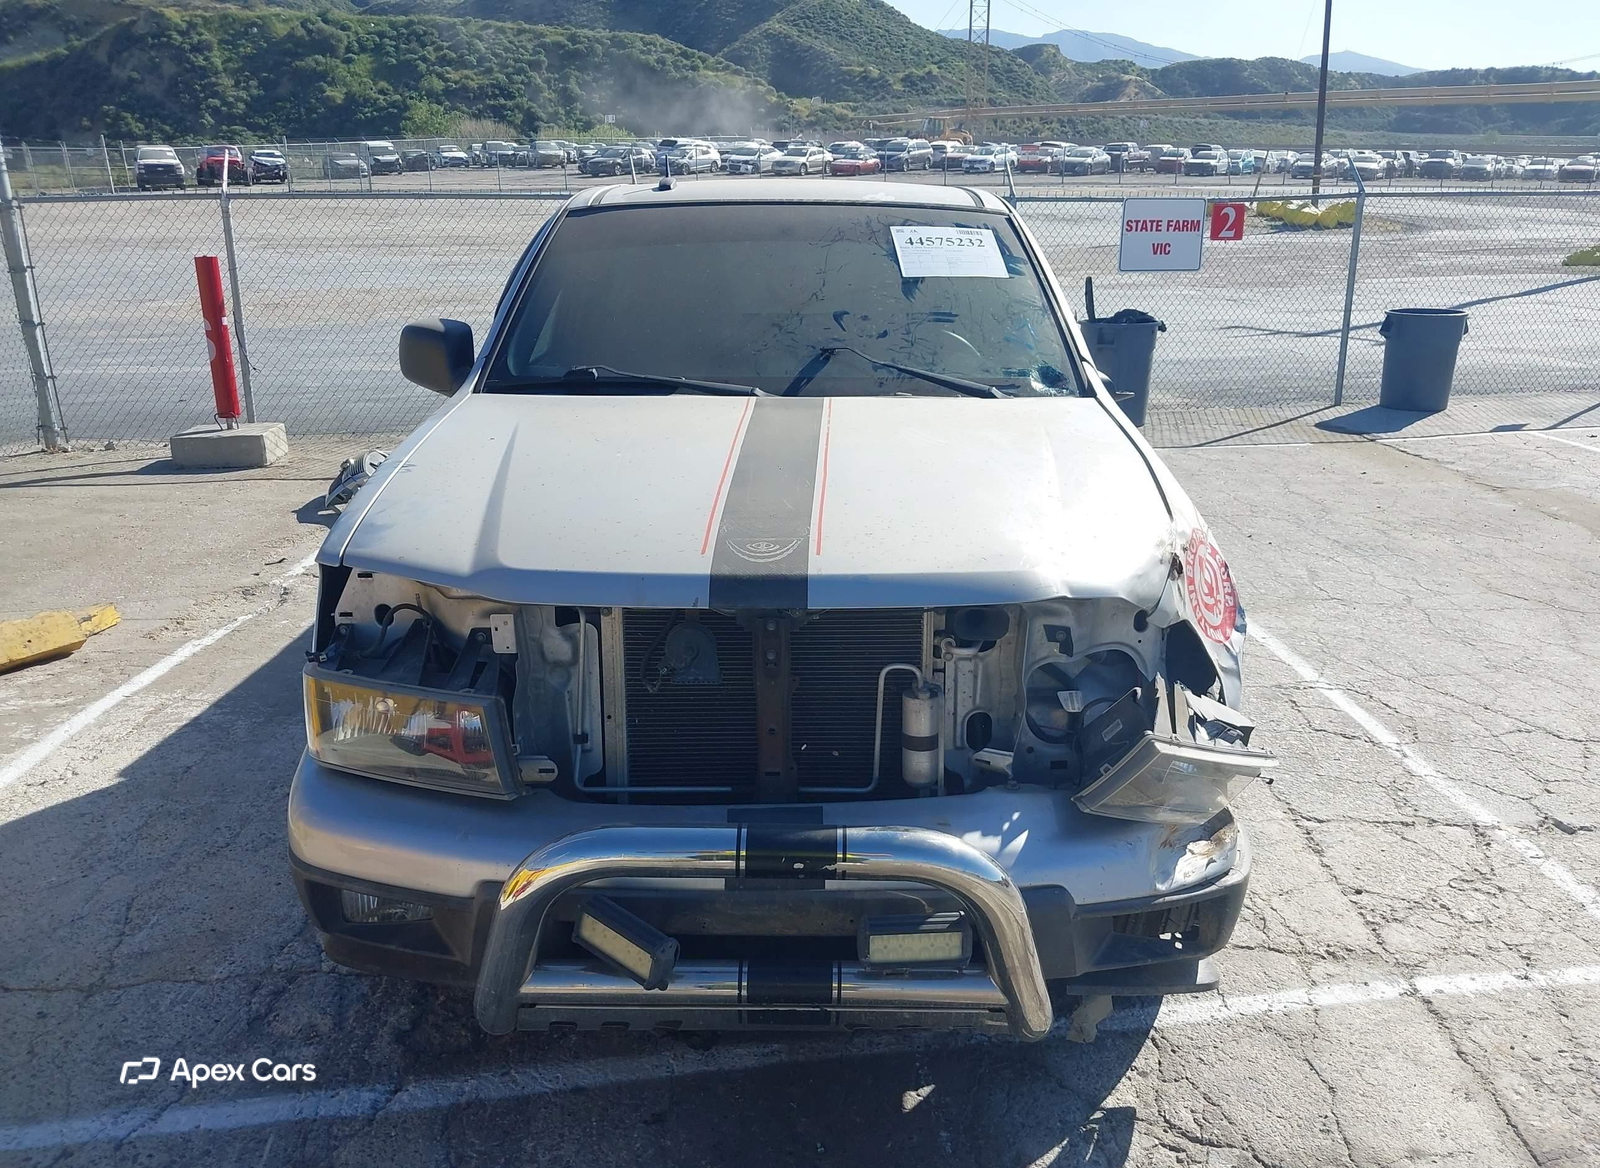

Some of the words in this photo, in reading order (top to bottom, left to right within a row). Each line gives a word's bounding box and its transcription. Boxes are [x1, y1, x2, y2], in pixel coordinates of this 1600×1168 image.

[1125, 219, 1162, 233] STATE
[1166, 219, 1201, 233] FARM
[1217, 206, 1237, 238] 2
[905, 236, 985, 248] 44575232
[1151, 242, 1171, 255] VIC
